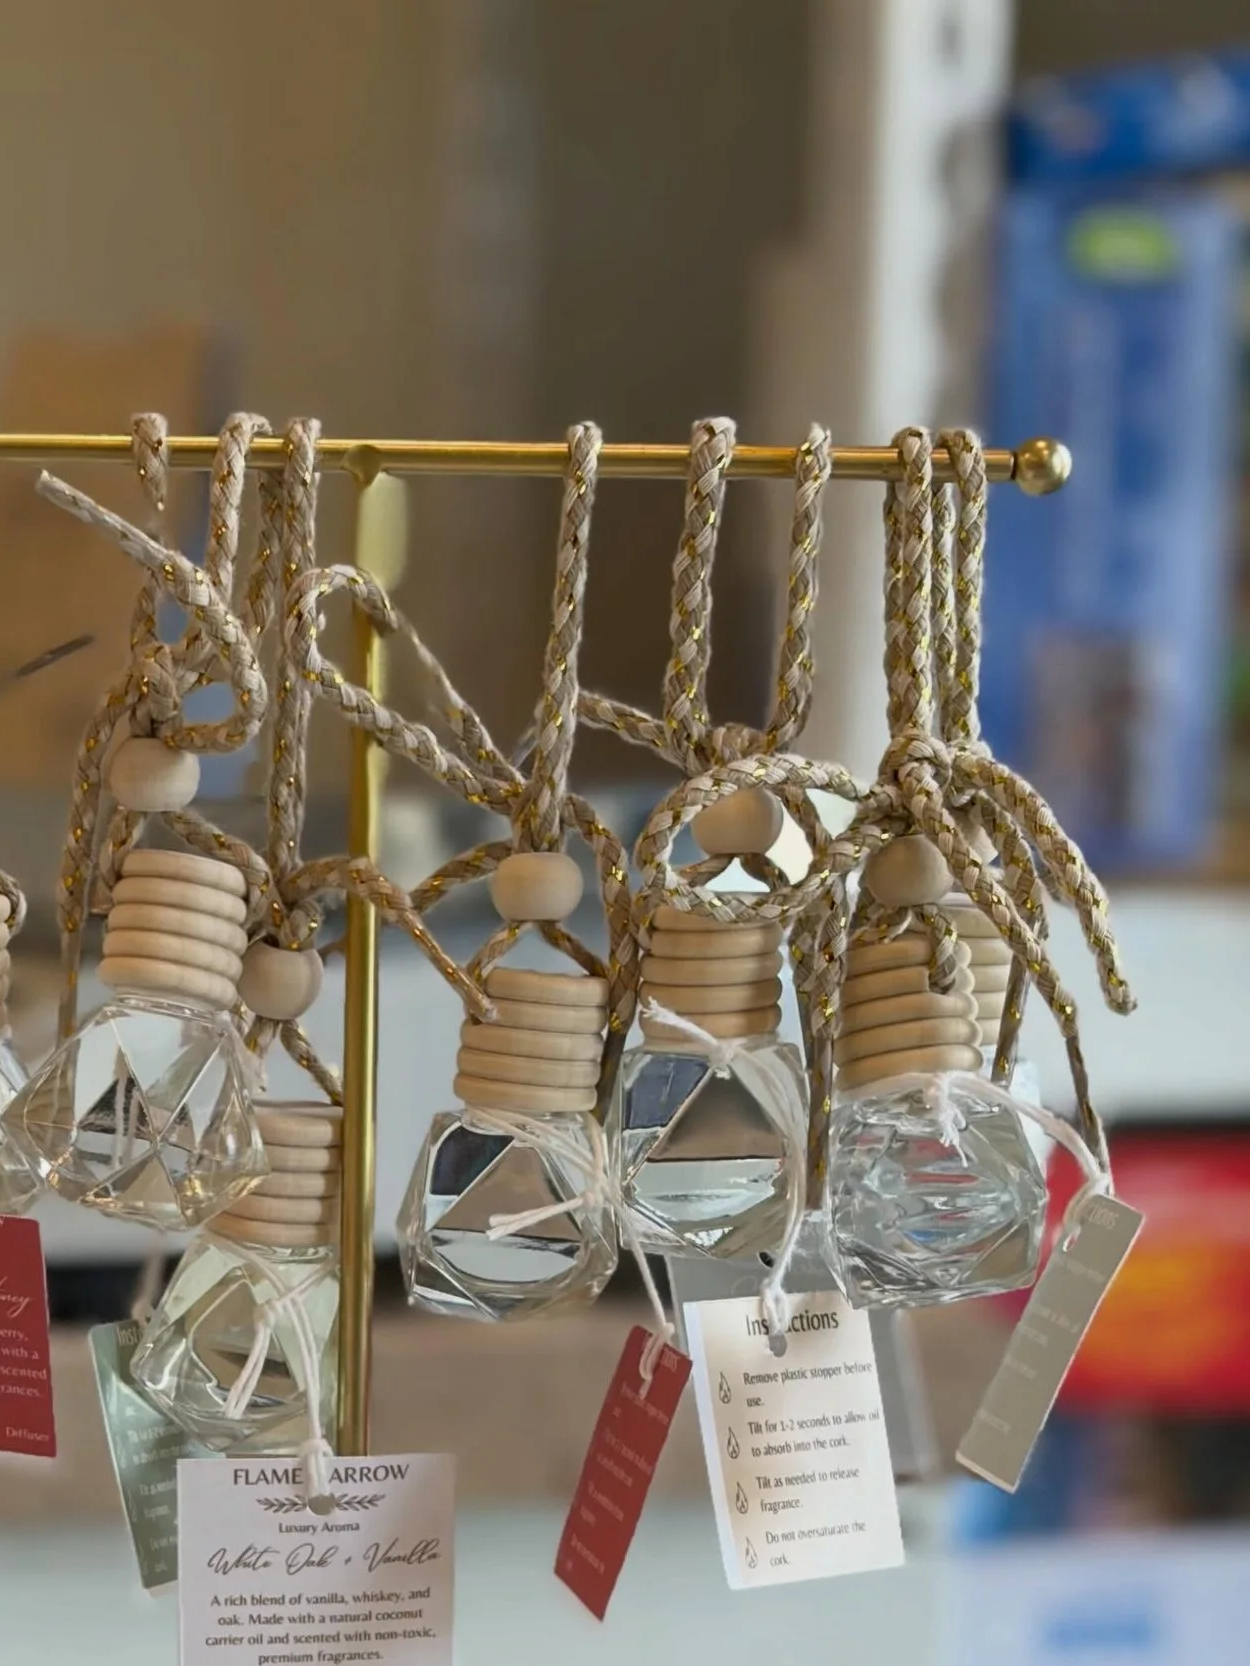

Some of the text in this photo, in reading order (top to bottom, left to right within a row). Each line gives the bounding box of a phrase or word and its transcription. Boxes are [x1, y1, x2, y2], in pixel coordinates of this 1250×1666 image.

[1, 1343, 28, 1358] with
[32, 1351, 39, 1360] a
[0, 1364, 47, 1380] scented
[743, 1361, 872, 1387] Remove plastic stopper before
[746, 1397, 764, 1407] use.
[748, 1409, 879, 1435] Tilt for 1-2 seconds to allow oil
[6, 1426, 49, 1442] Diffuser
[752, 1435, 849, 1457] to absorb into the cork.
[233, 1464, 410, 1485] FLAME ARROW
[756, 1467, 860, 1489] Tilt as needed to release
[760, 1499, 804, 1515] fragrance.
[279, 1522, 360, 1535] Luxury Aroma
[766, 1520, 866, 1544] Do not oversaturate the
[207, 1544, 281, 1576] White
[286, 1543, 339, 1575] Oak
[363, 1538, 441, 1573] Vanilla
[770, 1553, 791, 1567] cork.
[210, 1587, 430, 1607] A rich blend of vanilla, whiskey, and
[218, 1609, 423, 1626] oak. Made with a natural coconut
[205, 1627, 436, 1646] carrier oil and scented with non-toxic,
[258, 1650, 383, 1666] premium fragrances.
